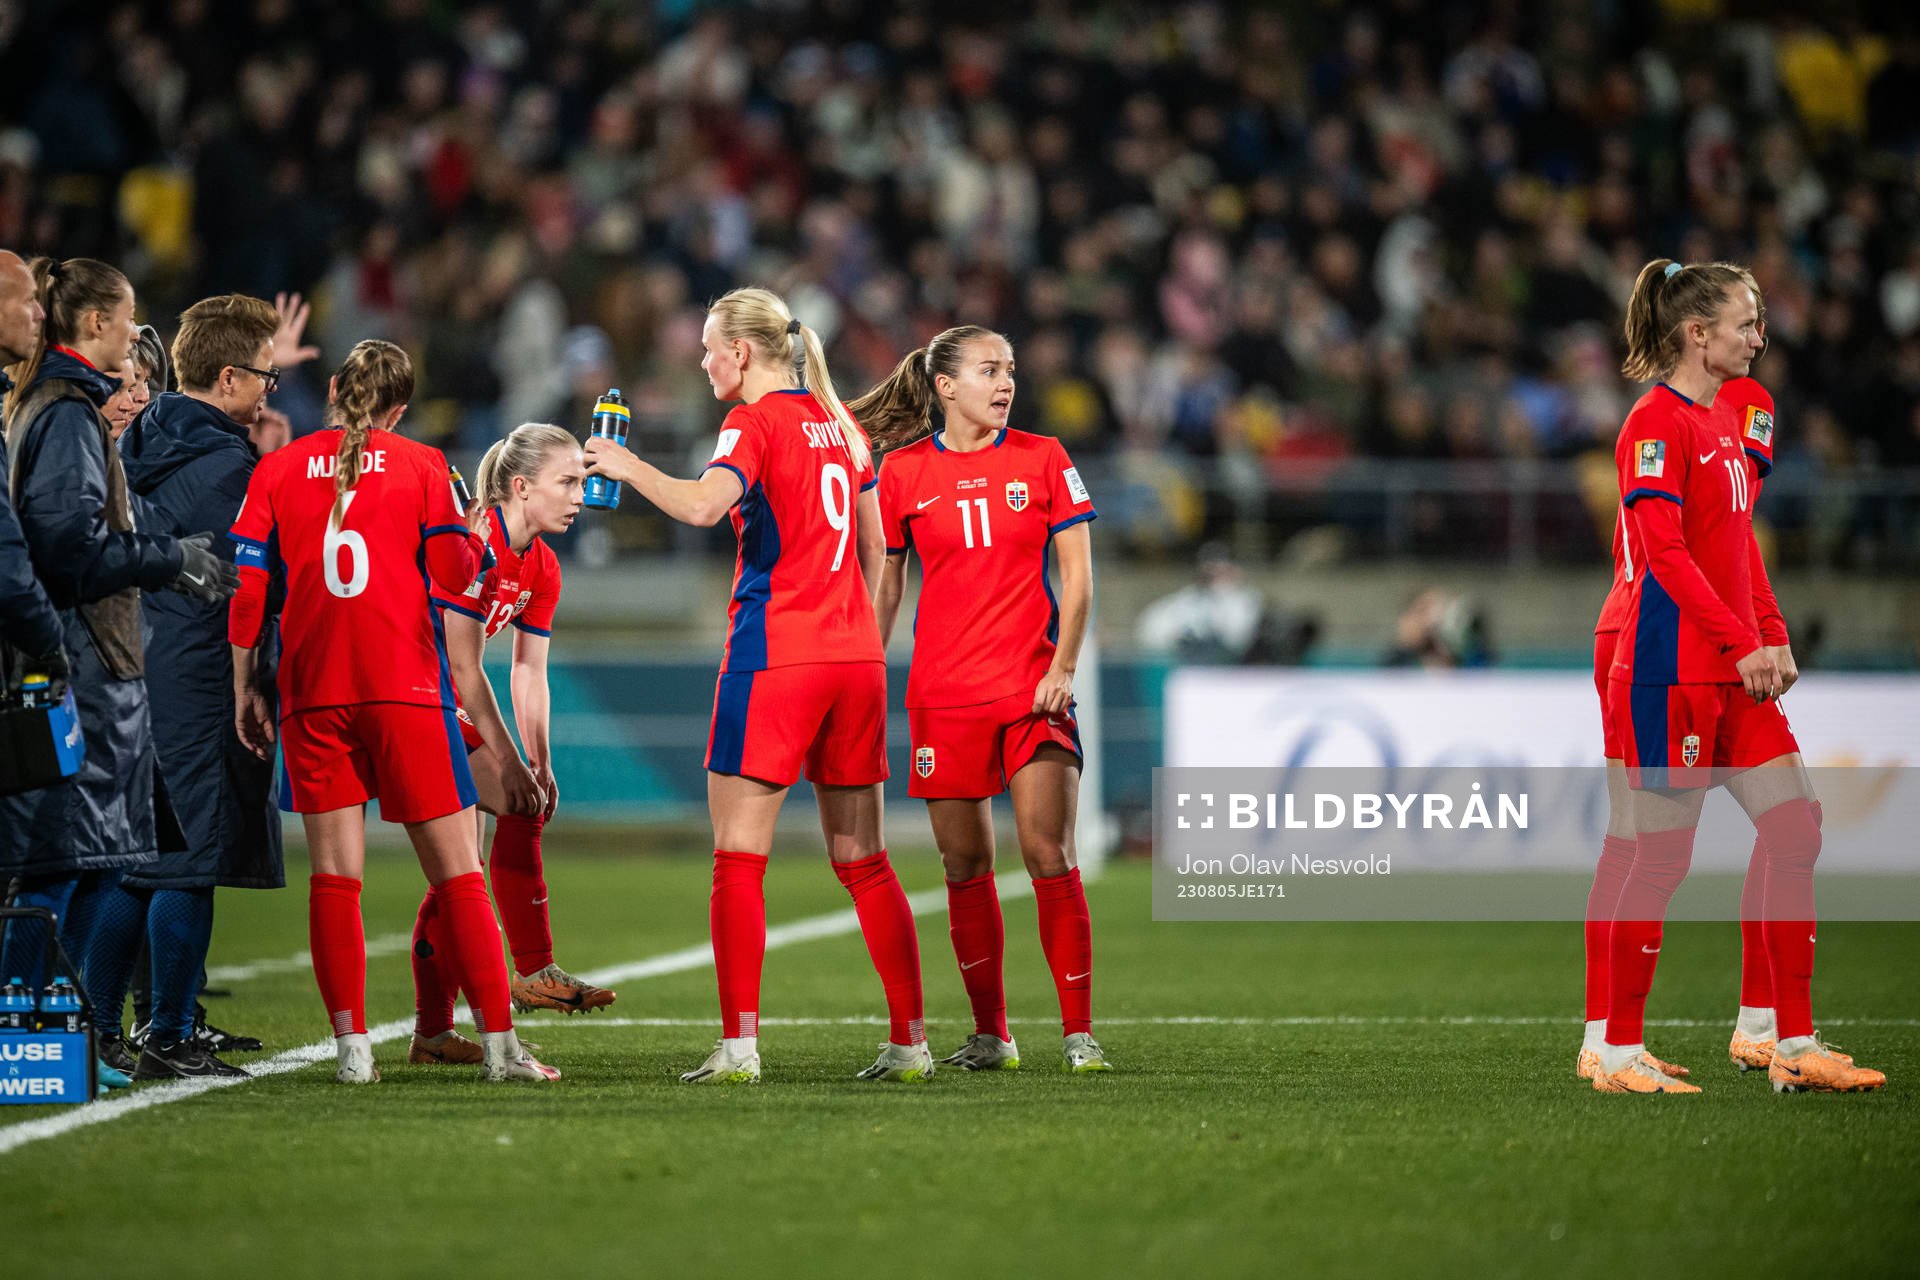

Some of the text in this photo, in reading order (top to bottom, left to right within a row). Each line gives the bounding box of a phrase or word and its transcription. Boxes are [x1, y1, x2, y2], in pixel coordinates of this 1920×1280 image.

[307, 450, 386, 479] MJDE
[1724, 458, 1748, 512] 10
[323, 490, 369, 598] 6
[820, 463, 850, 572] 9
[956, 497, 992, 549] 11
[485, 600, 514, 638] 13
